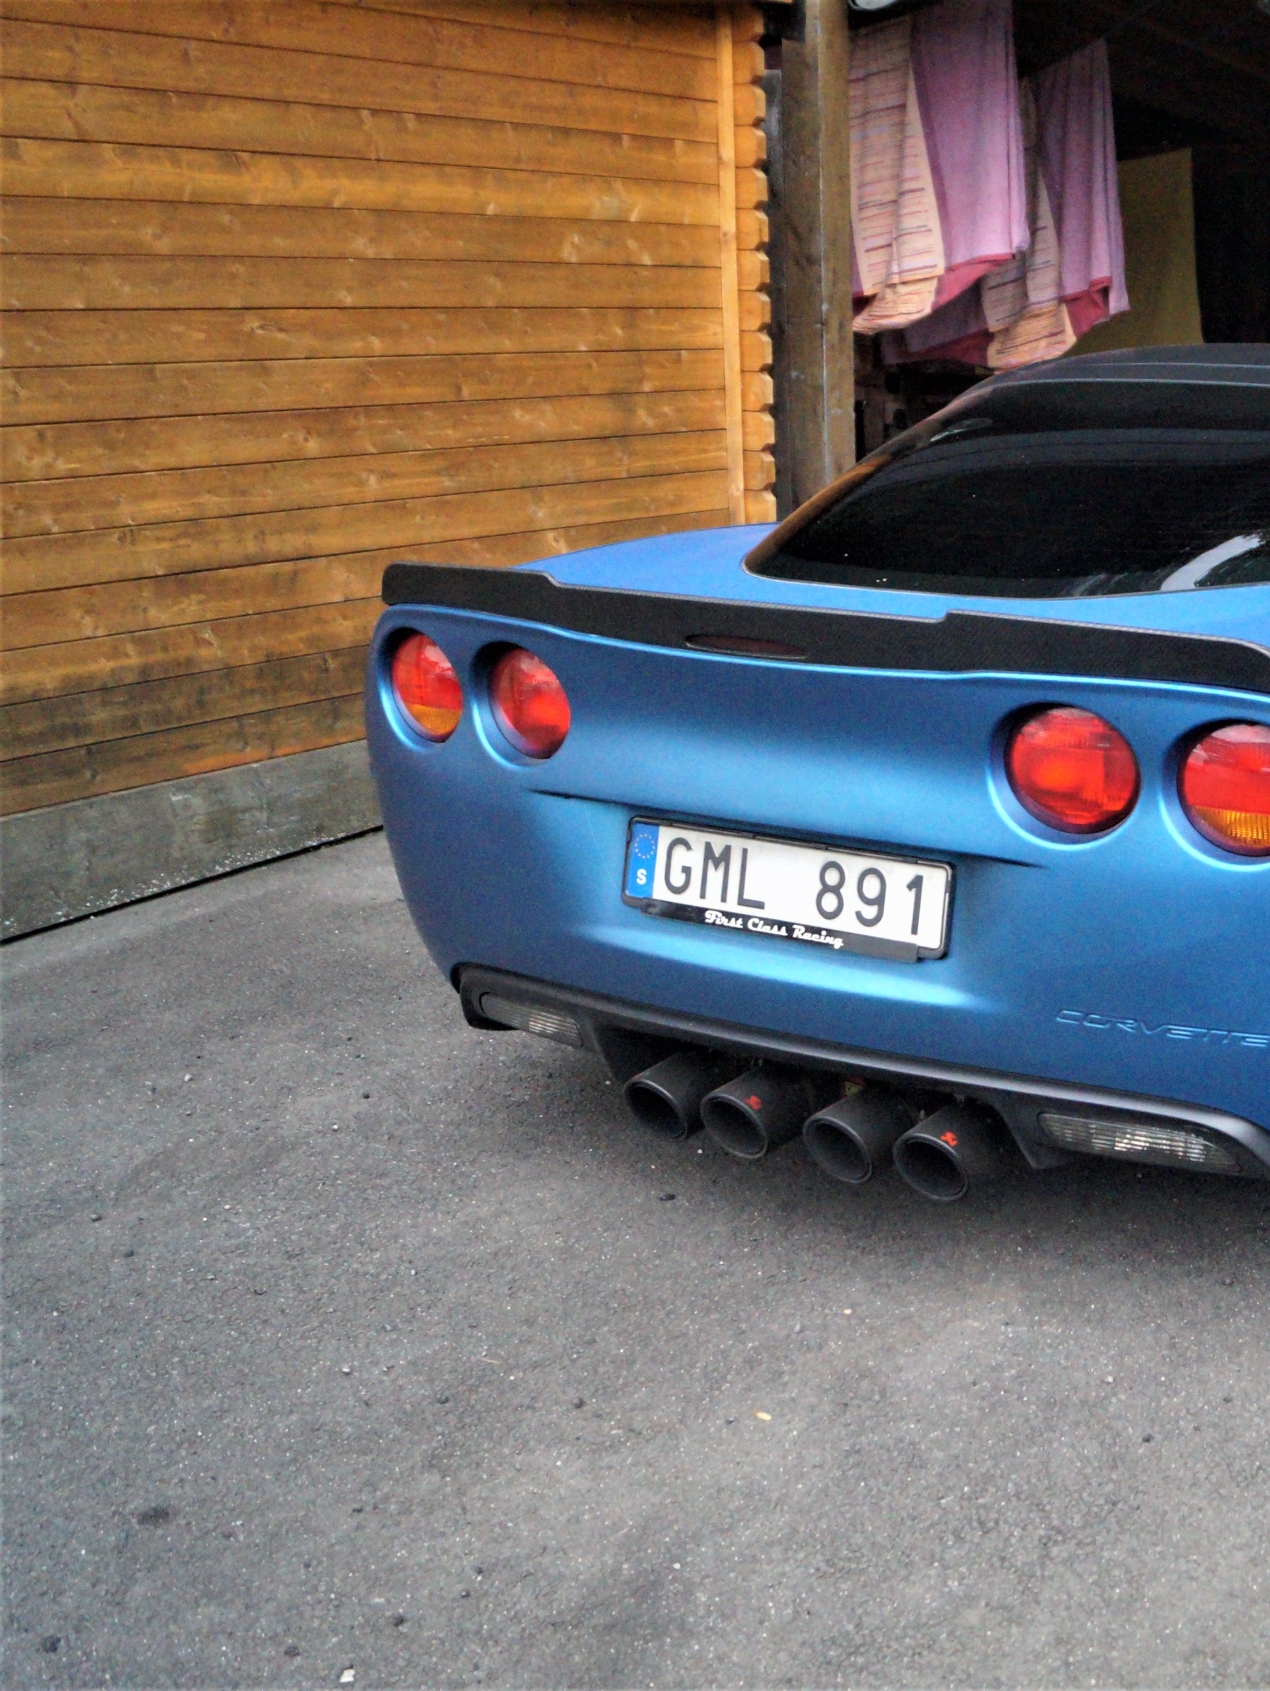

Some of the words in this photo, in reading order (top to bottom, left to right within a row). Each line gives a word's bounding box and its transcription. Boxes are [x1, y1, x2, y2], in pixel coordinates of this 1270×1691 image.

[636, 868, 648, 885] S
[664, 837, 765, 910] GML
[815, 860, 924, 936] 891
[704, 910, 743, 928] First
[747, 918, 788, 936] Class
[792, 925, 844, 949] Racing
[1056, 1009, 1270, 1048] CORVETTE
